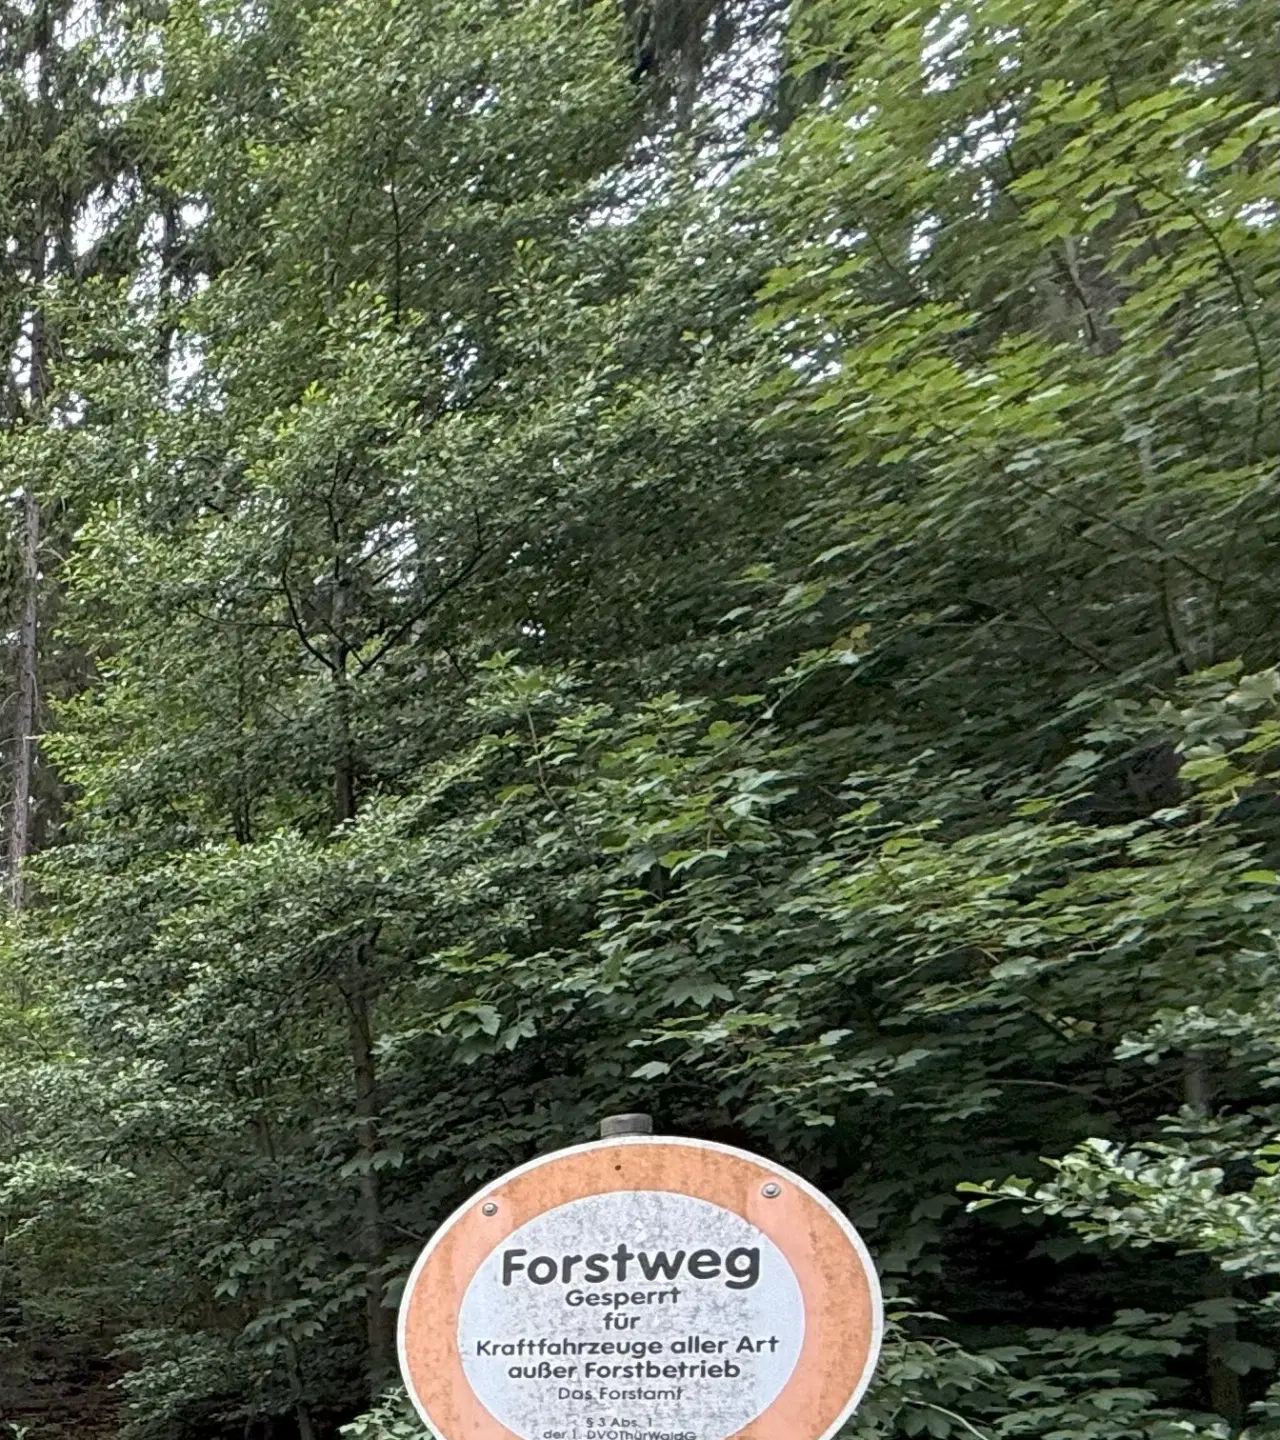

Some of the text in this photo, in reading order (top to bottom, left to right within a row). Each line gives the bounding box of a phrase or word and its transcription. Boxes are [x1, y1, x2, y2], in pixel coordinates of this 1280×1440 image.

[502, 1243, 760, 1290] Forstweg
[565, 1286, 681, 1310] Gesperrt
[602, 1311, 641, 1331] für
[476, 1335, 780, 1359] Kraftfahrzeuge aller Art
[507, 1359, 741, 1379] außer Forstbetrieb
[557, 1386, 684, 1400] Das Forstamt
[597, 1417, 606, 1428] 3
[542, 1429, 567, 1440] der
